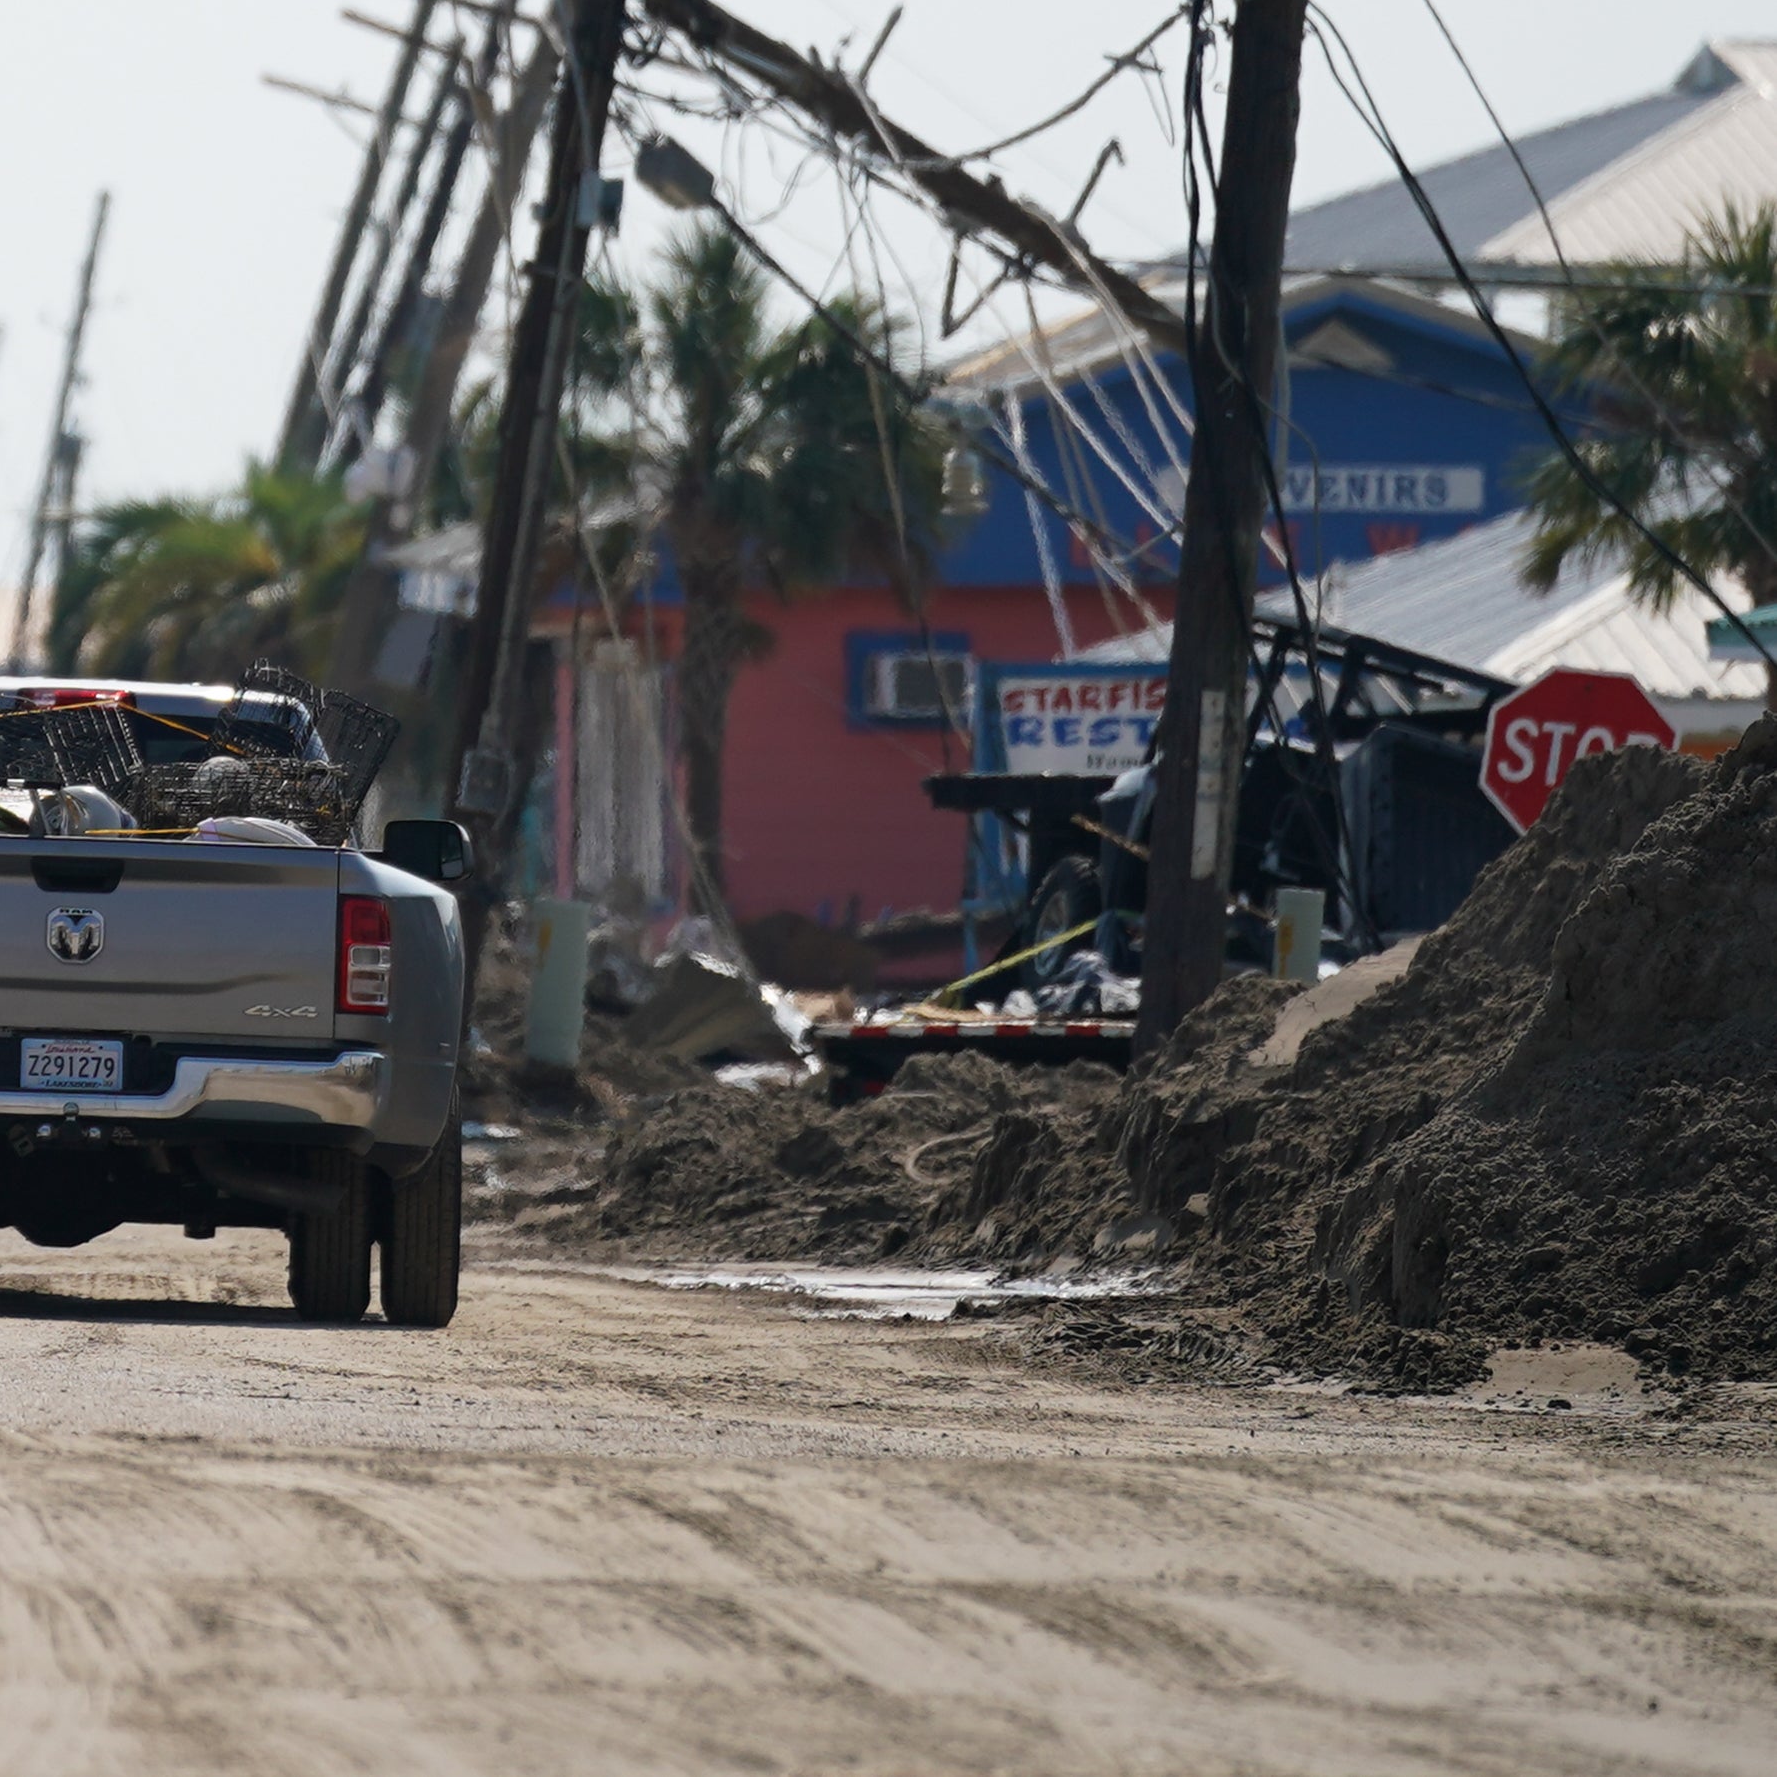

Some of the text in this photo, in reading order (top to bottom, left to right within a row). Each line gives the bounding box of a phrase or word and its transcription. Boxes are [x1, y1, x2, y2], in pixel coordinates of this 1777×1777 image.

[1002, 676, 1167, 714] STARFIS
[1498, 719, 1660, 786] STO
[243, 1005, 318, 1018] 4x4
[28, 1055, 115, 1078] Z291279
